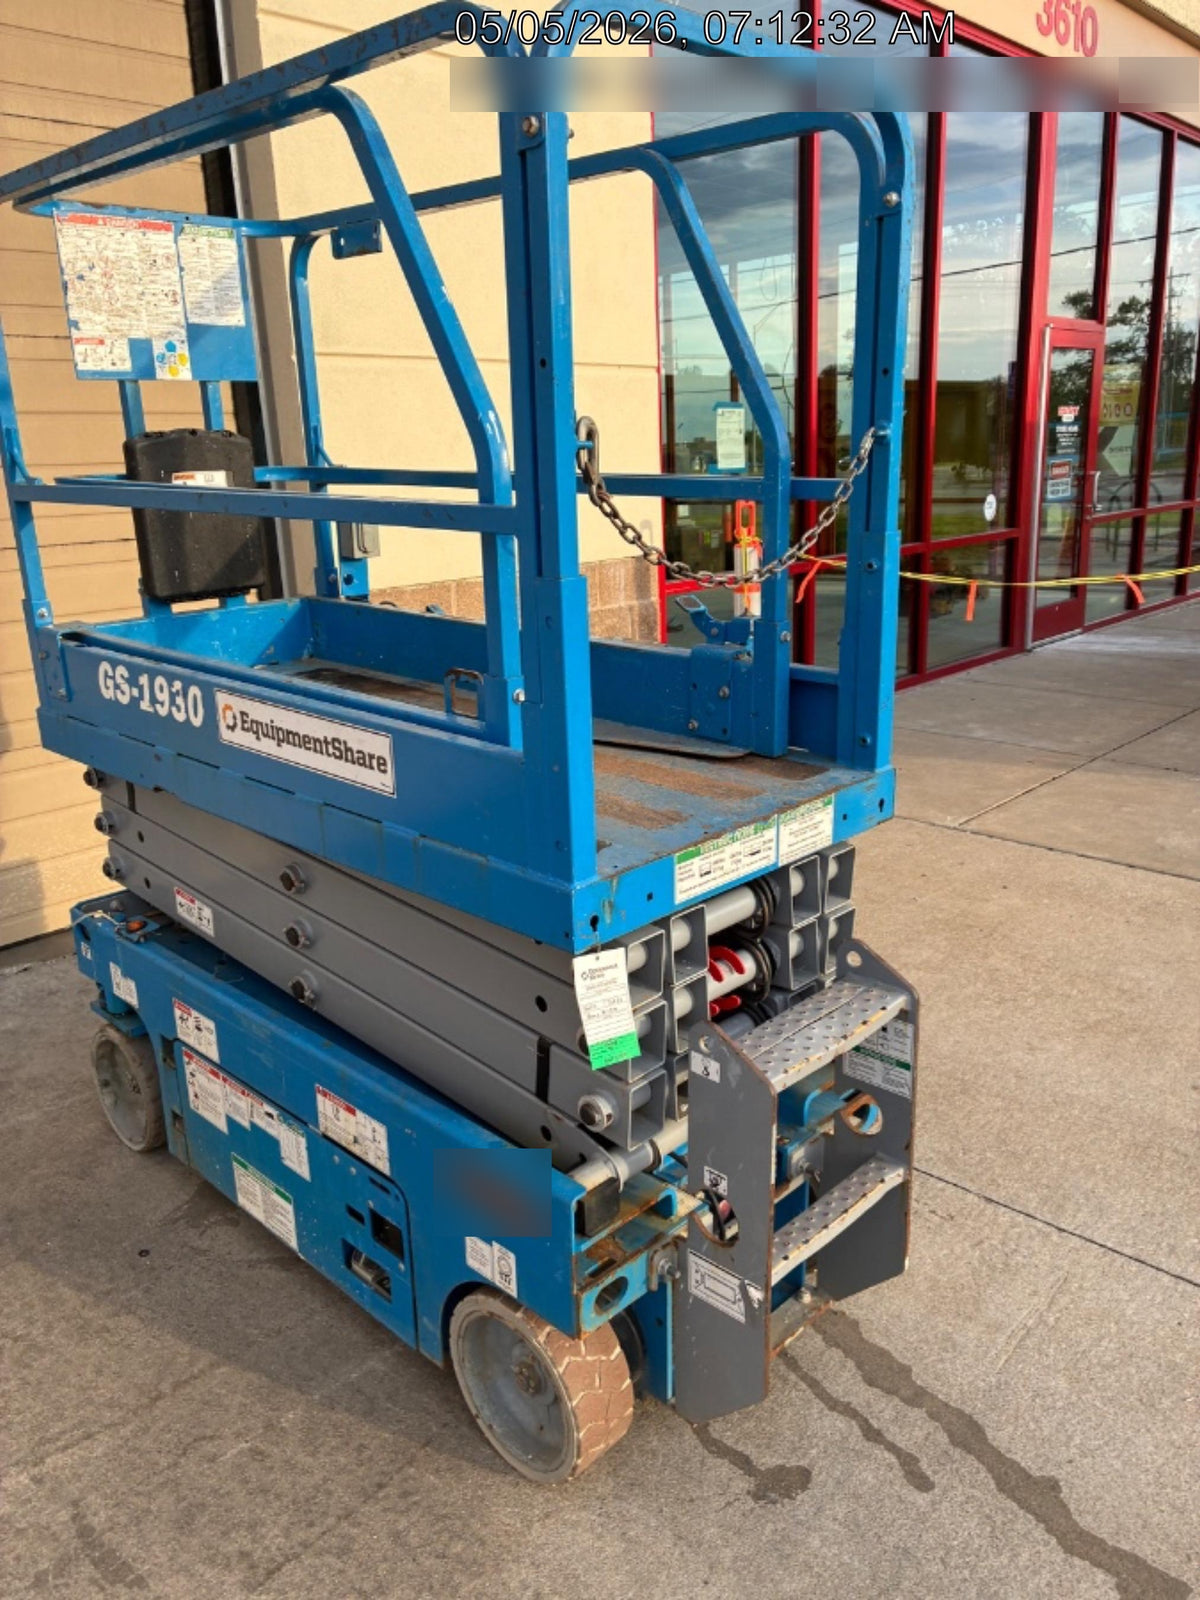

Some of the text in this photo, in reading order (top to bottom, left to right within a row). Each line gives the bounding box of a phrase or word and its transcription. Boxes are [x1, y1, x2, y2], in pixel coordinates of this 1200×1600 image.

[1036, 0, 1098, 57] 3610
[98, 661, 205, 727] GS-1930
[239, 709, 389, 774] EquipmentShare
